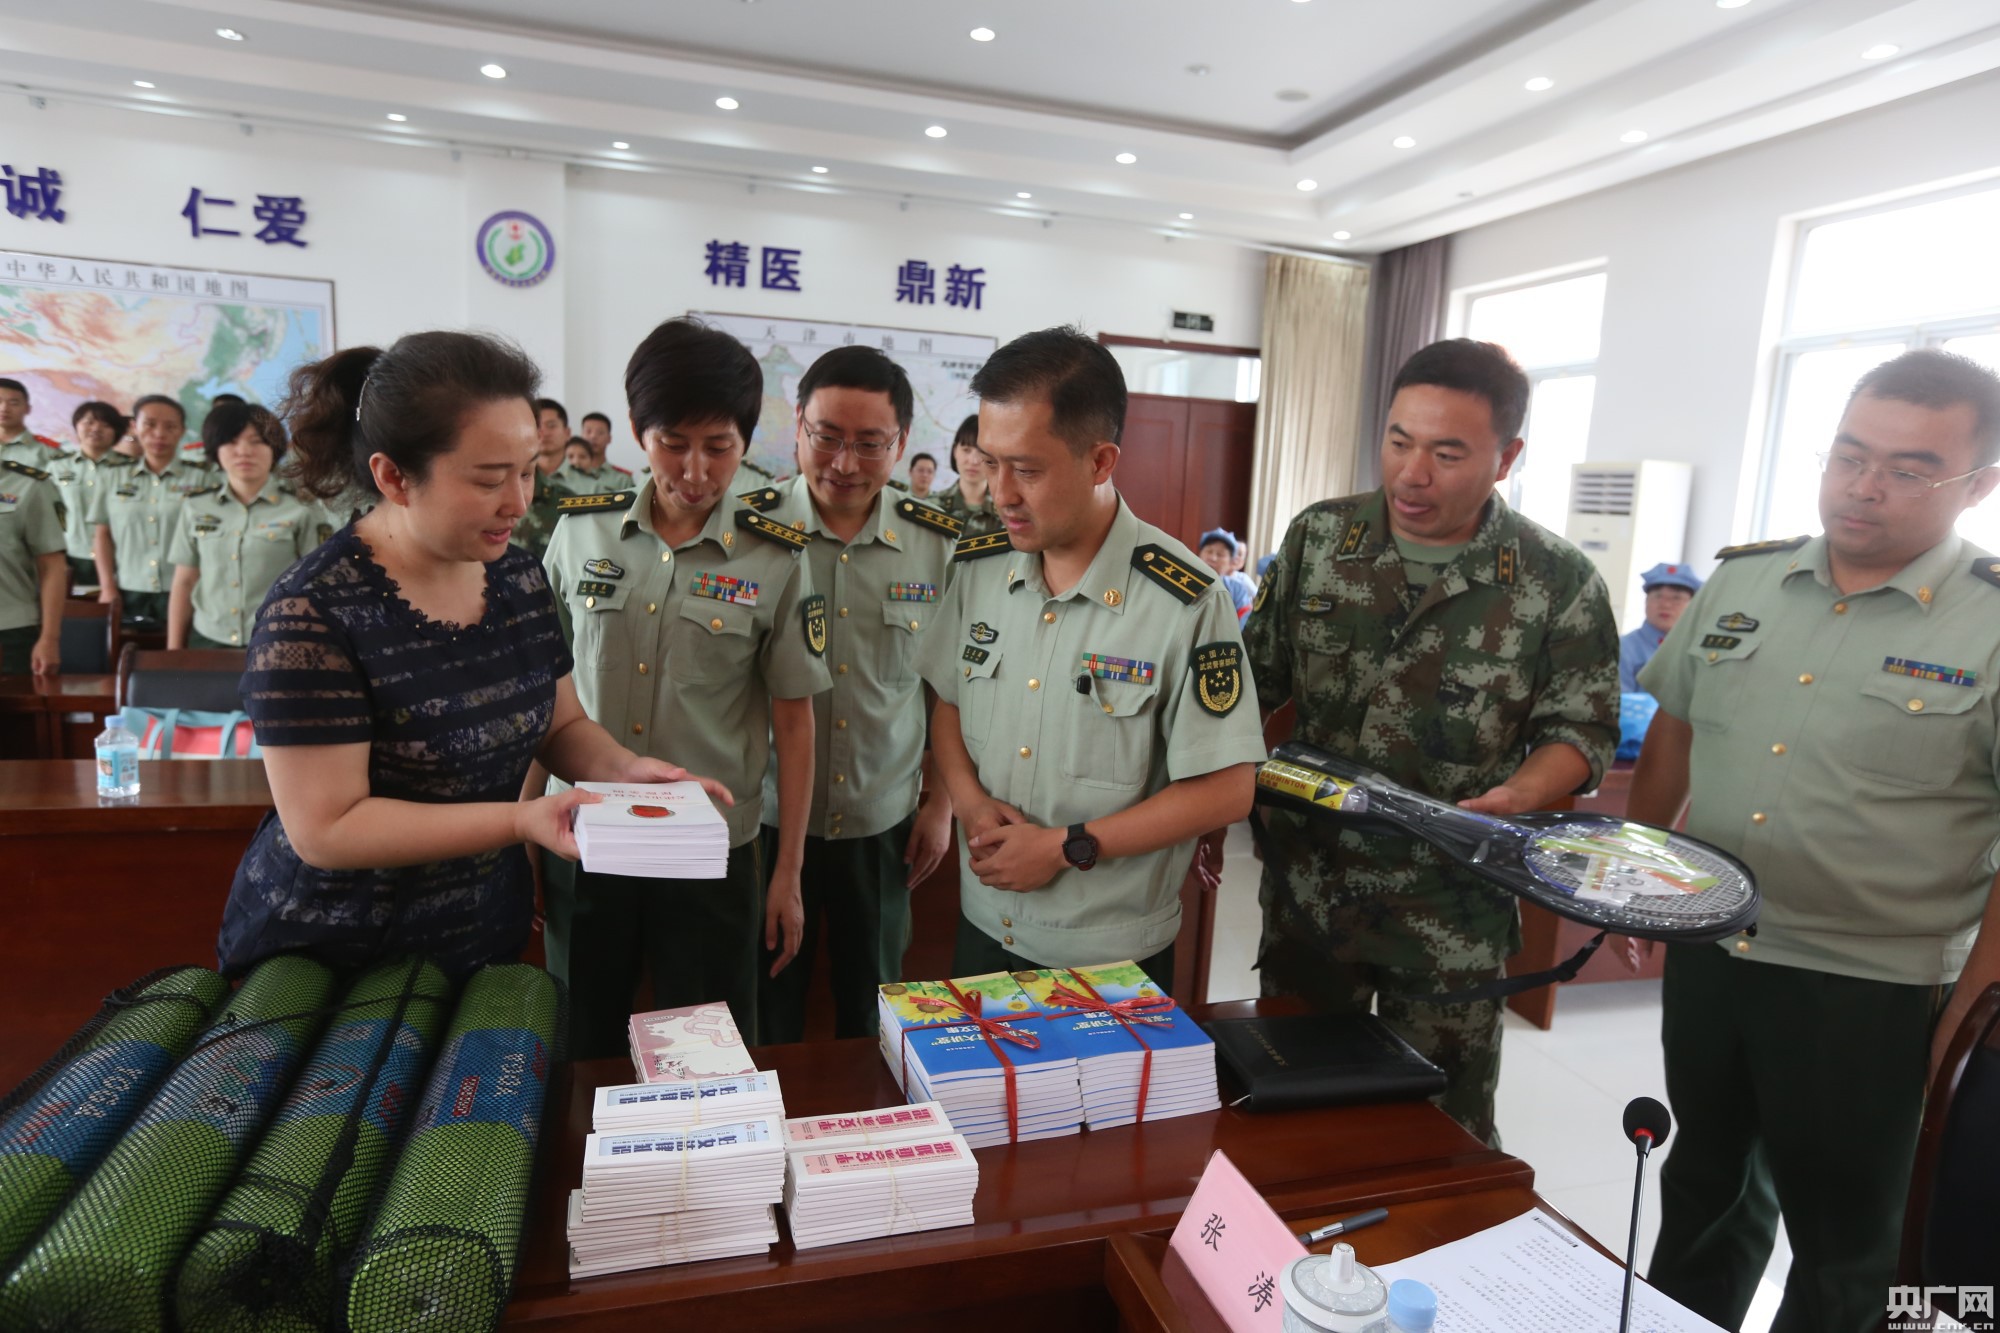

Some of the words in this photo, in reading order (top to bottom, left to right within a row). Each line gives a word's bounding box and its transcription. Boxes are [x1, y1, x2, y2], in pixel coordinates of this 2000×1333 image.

[0, 164, 67, 224] 诚
[181, 187, 310, 248] 仁爱
[6, 259, 250, 298] 中华人民共和国地图
[704, 239, 803, 292] 精医
[896, 259, 987, 310] 鼎新
[763, 325, 933, 352] 天津市地图
[1260, 770, 1307, 790] BADMINTON
[73, 1066, 143, 1118] YOGA
[493, 1053, 526, 1097] YOGA
[817, 1108, 931, 1131] 平安家庭知识
[835, 1142, 955, 1164] 平安家庭知识
[1200, 1213, 1276, 1313] 张涛
